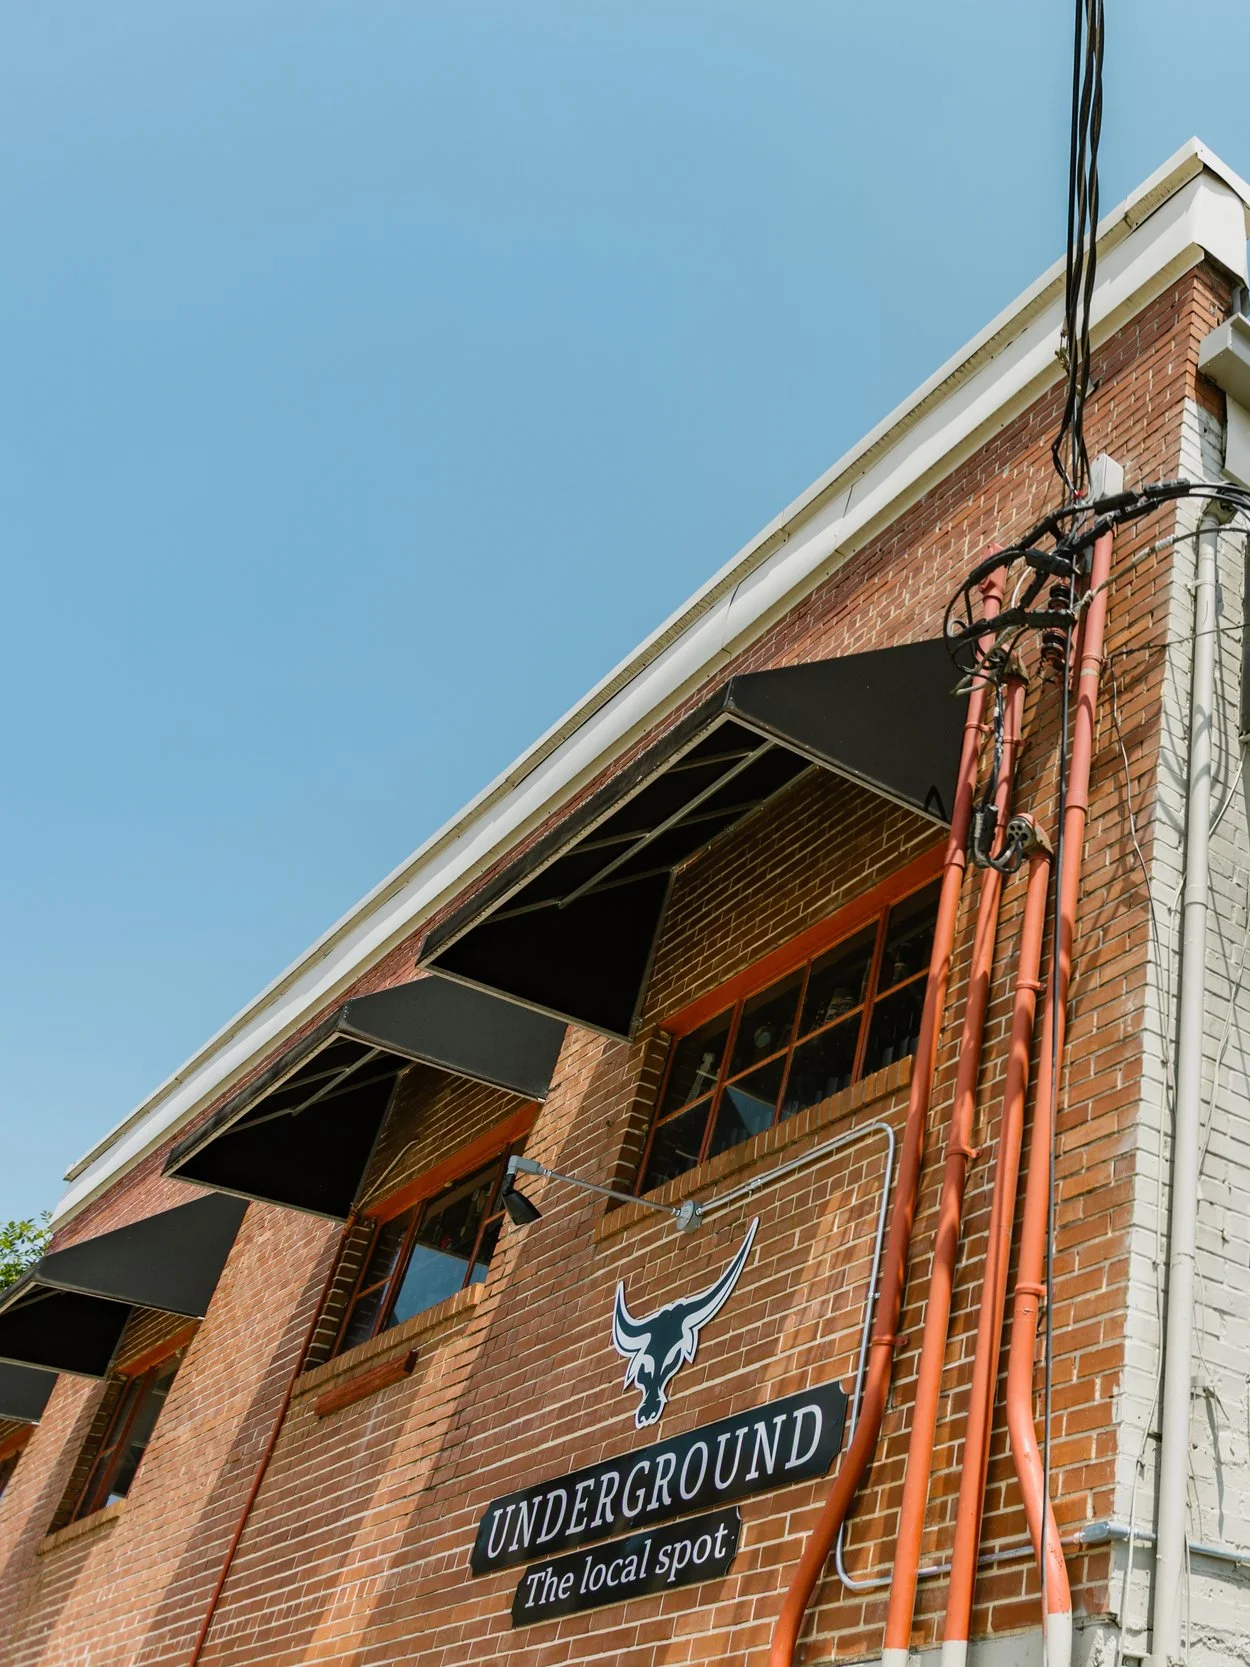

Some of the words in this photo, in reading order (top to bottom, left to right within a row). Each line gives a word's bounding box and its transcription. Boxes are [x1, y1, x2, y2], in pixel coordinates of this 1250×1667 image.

[486, 1403, 825, 1559] UNDERGROUND
[524, 1567, 575, 1608] The
[579, 1539, 653, 1594] local
[654, 1522, 729, 1583] spot
